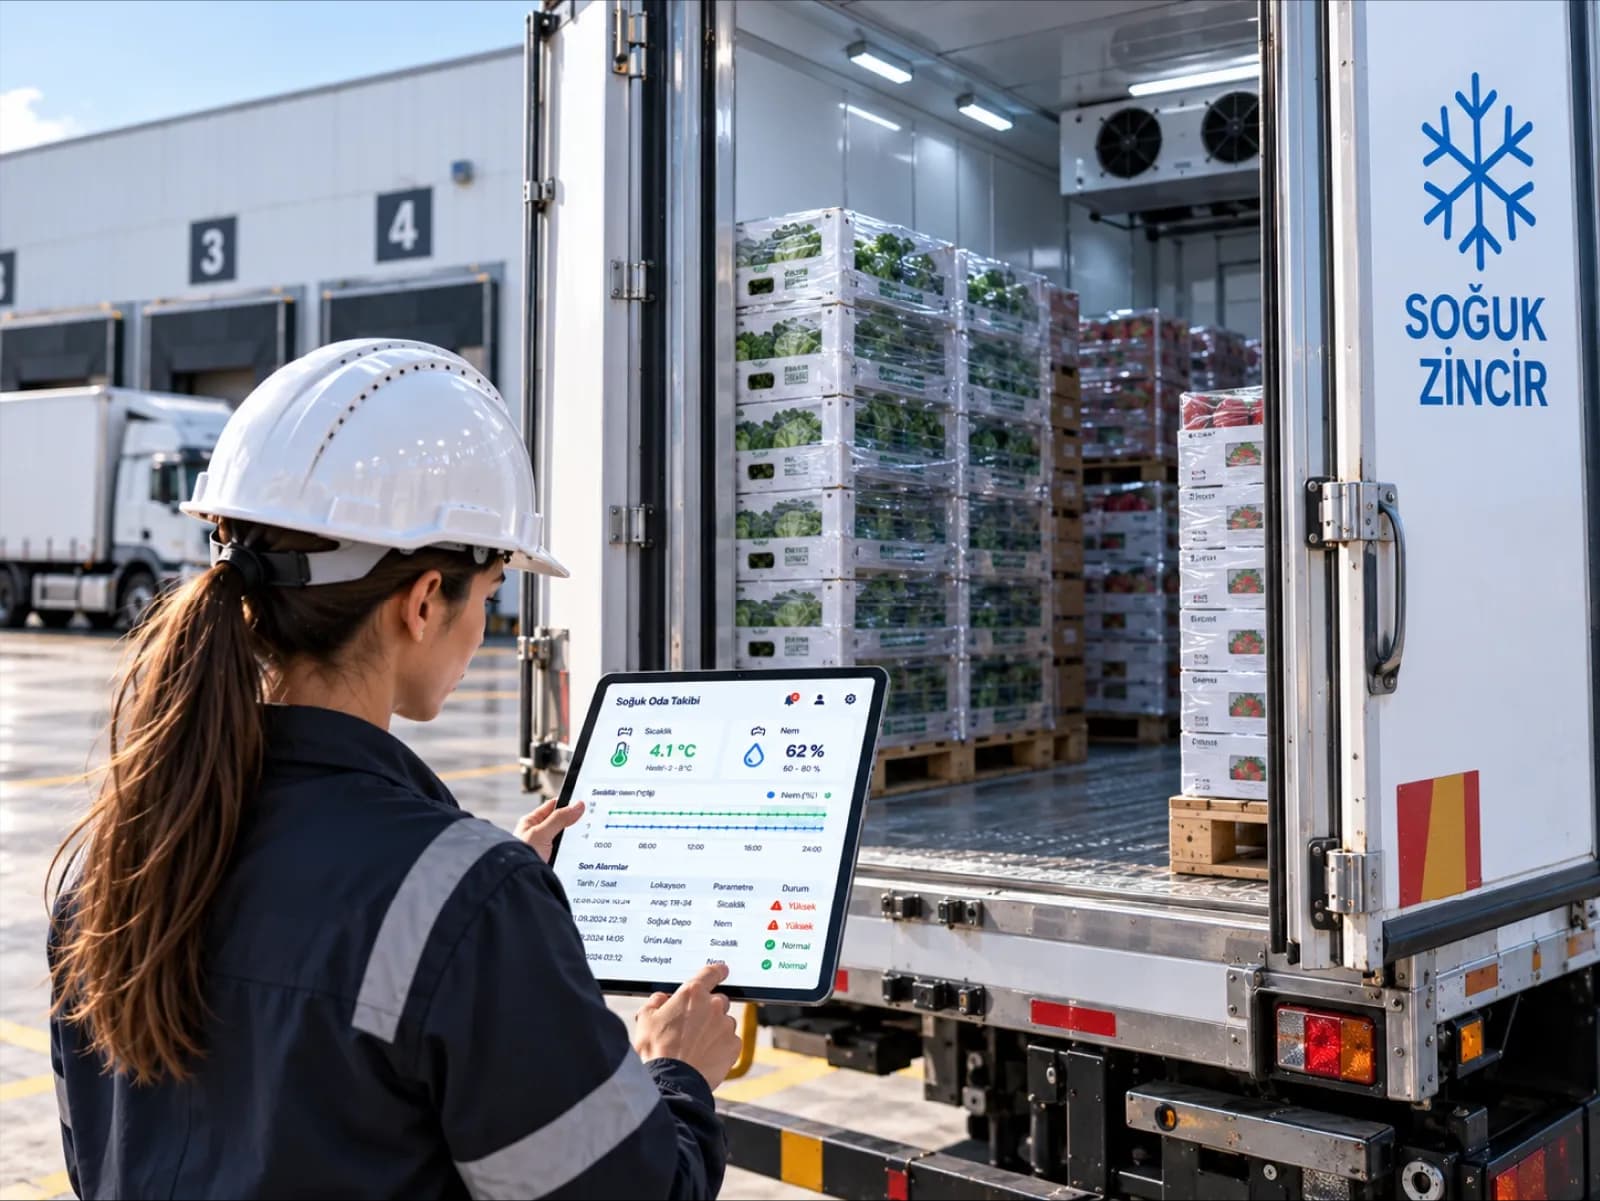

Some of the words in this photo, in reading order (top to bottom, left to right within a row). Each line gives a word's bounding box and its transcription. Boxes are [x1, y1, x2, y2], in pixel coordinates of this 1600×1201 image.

[388, 201, 418, 250] 4
[201, 228, 224, 275] 3
[1405, 283, 1547, 341] SOĞUK
[1419, 346, 1548, 407] ZİNCİR
[616, 697, 646, 708] Soğuk
[649, 696, 669, 705] Oda
[671, 695, 701, 705] Takibi
[780, 727, 800, 735] Nem
[649, 744, 672, 757] 4.1
[678, 744, 697, 758] °C
[786, 744, 807, 758] 62
[810, 744, 825, 758] %
[578, 862, 595, 870] Son
[595, 863, 629, 871] Alarmlar
[782, 884, 810, 893] Durum
[647, 917, 670, 927] Soğuk
[671, 918, 692, 927] Depo
[713, 920, 733, 928] Nem
[782, 942, 811, 950] Normal
[778, 962, 808, 970] Normal
